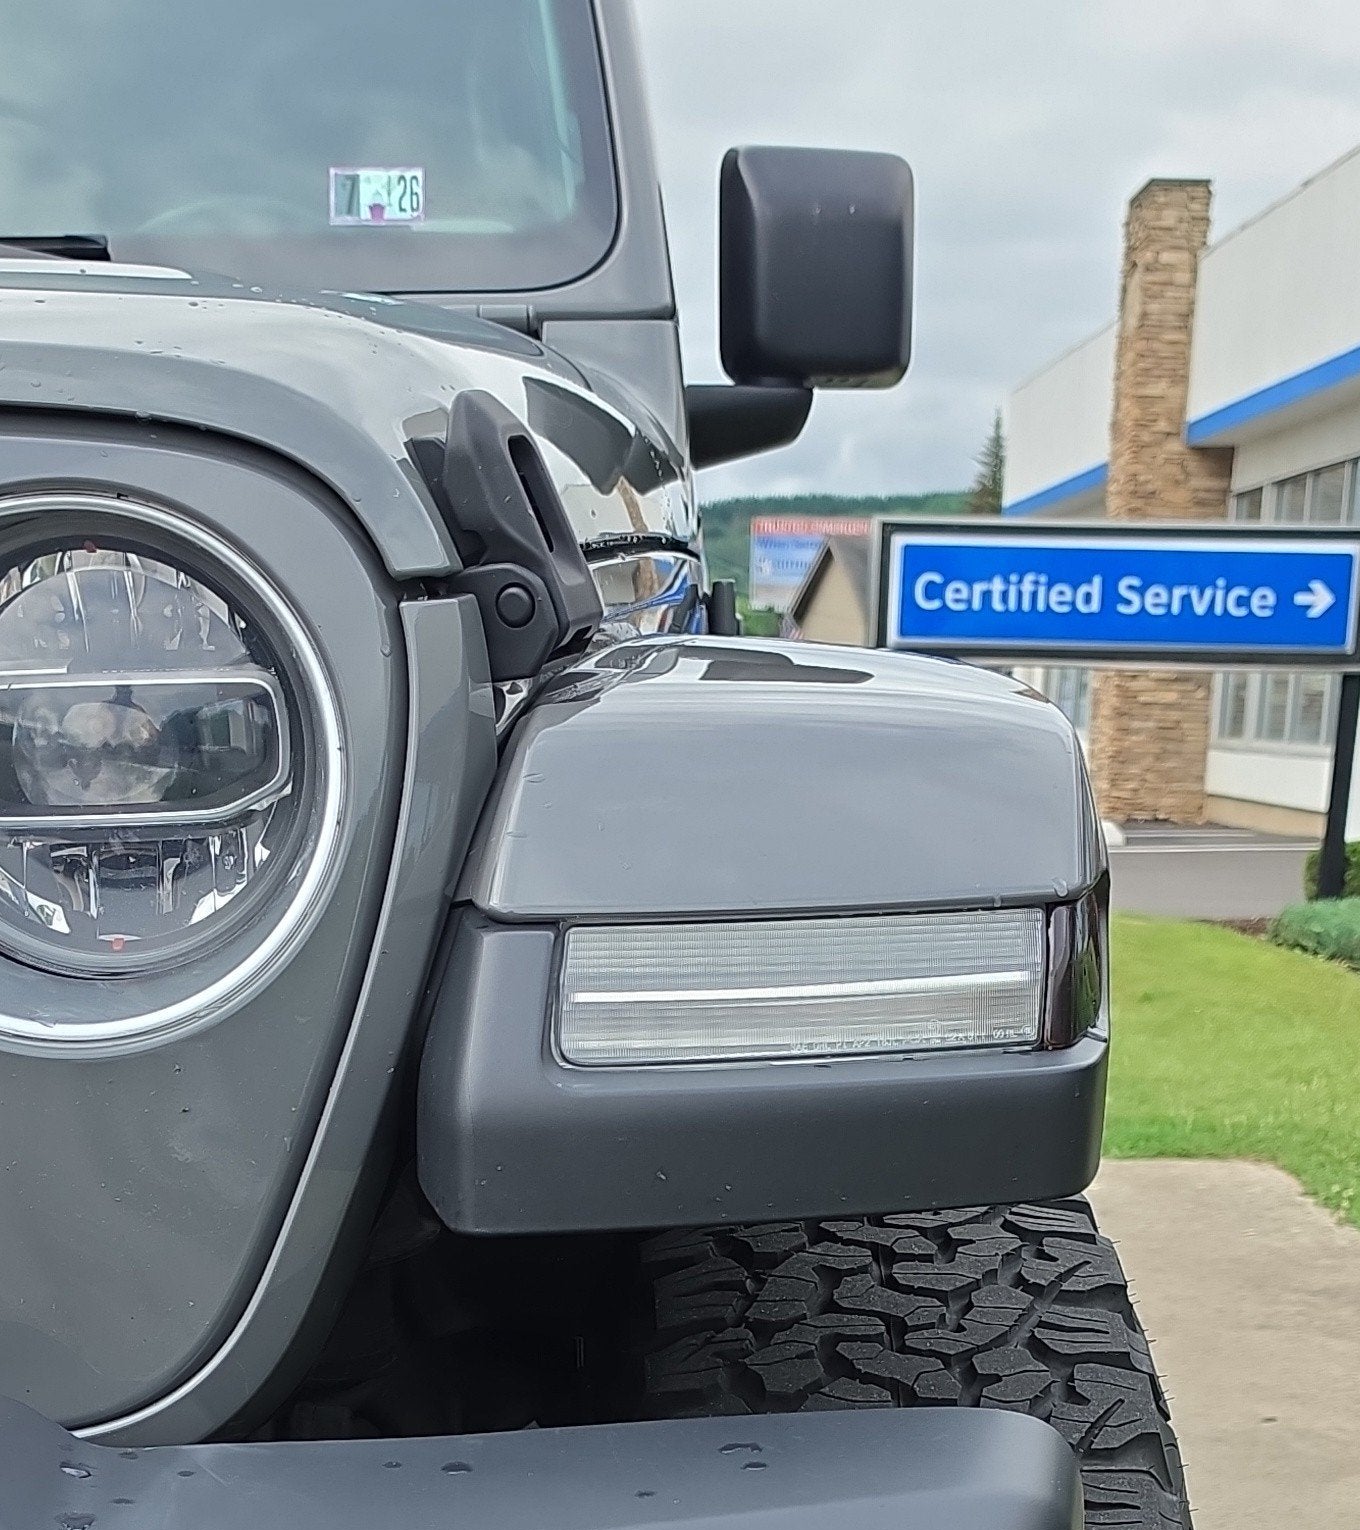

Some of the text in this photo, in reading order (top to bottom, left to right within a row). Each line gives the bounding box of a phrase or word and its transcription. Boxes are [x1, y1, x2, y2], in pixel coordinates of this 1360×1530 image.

[344, 174, 420, 214] 7 26
[914, 571, 1278, 617] Certified Service
